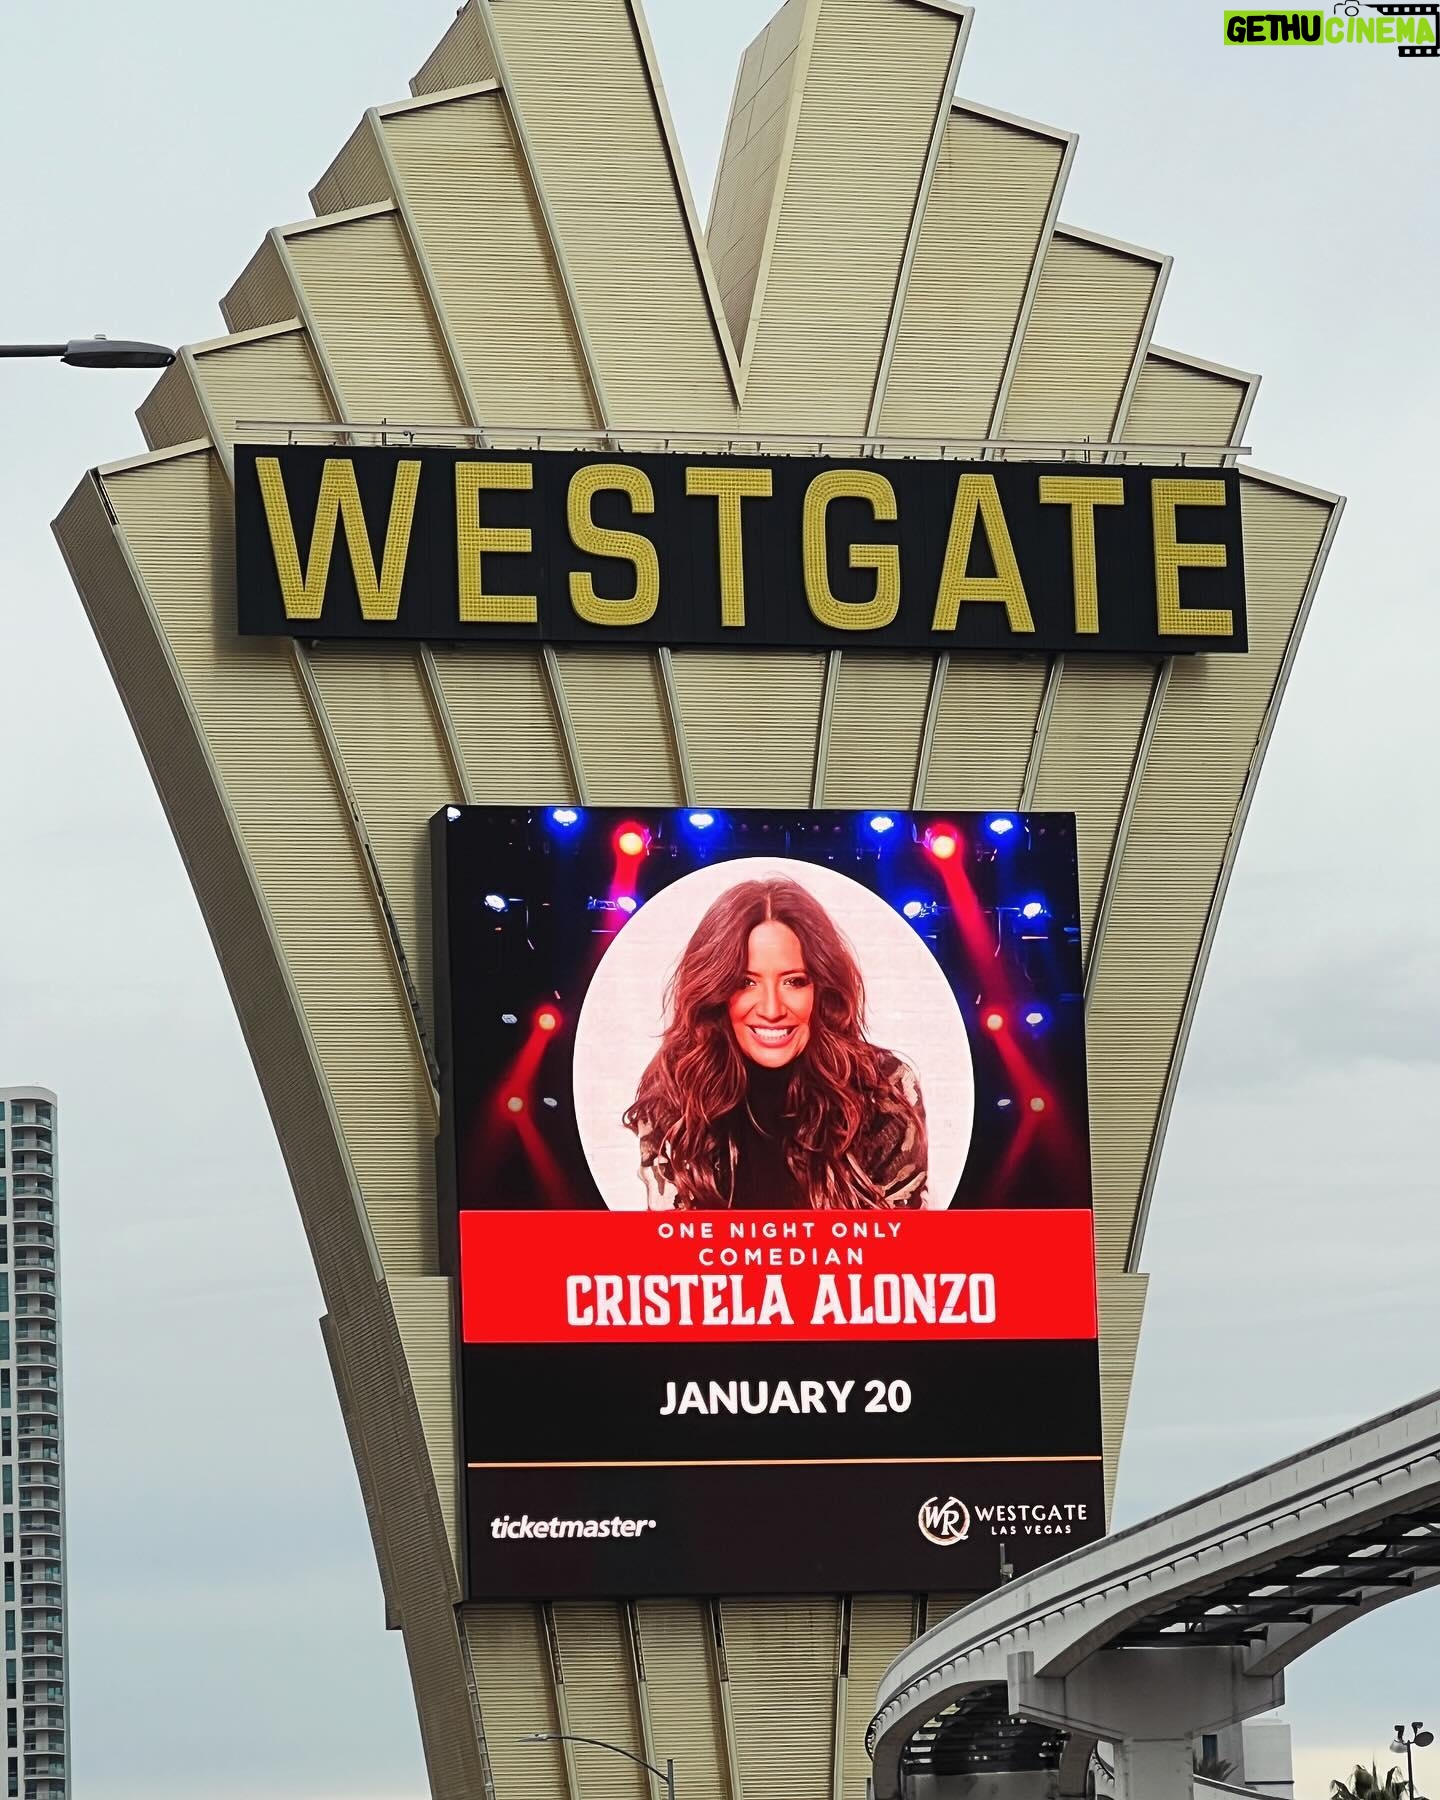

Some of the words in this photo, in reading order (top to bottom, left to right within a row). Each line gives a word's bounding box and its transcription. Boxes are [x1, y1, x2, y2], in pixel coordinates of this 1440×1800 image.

[256, 458, 1232, 635] WESTGATE
[658, 1223, 713, 1238] ONE
[730, 1223, 814, 1238] NIGHT
[832, 1222, 901, 1238] ONLY
[699, 1248, 862, 1266] COMEDIAN
[567, 1274, 794, 1326] CRISTELA
[810, 1273, 996, 1324] ALONZO
[660, 1380, 855, 1415] JANUARY
[865, 1380, 911, 1412] 20
[975, 1504, 1087, 1521] WESTGATE
[992, 1526, 1016, 1535] LAS
[1025, 1525, 1071, 1534] VEGAS
